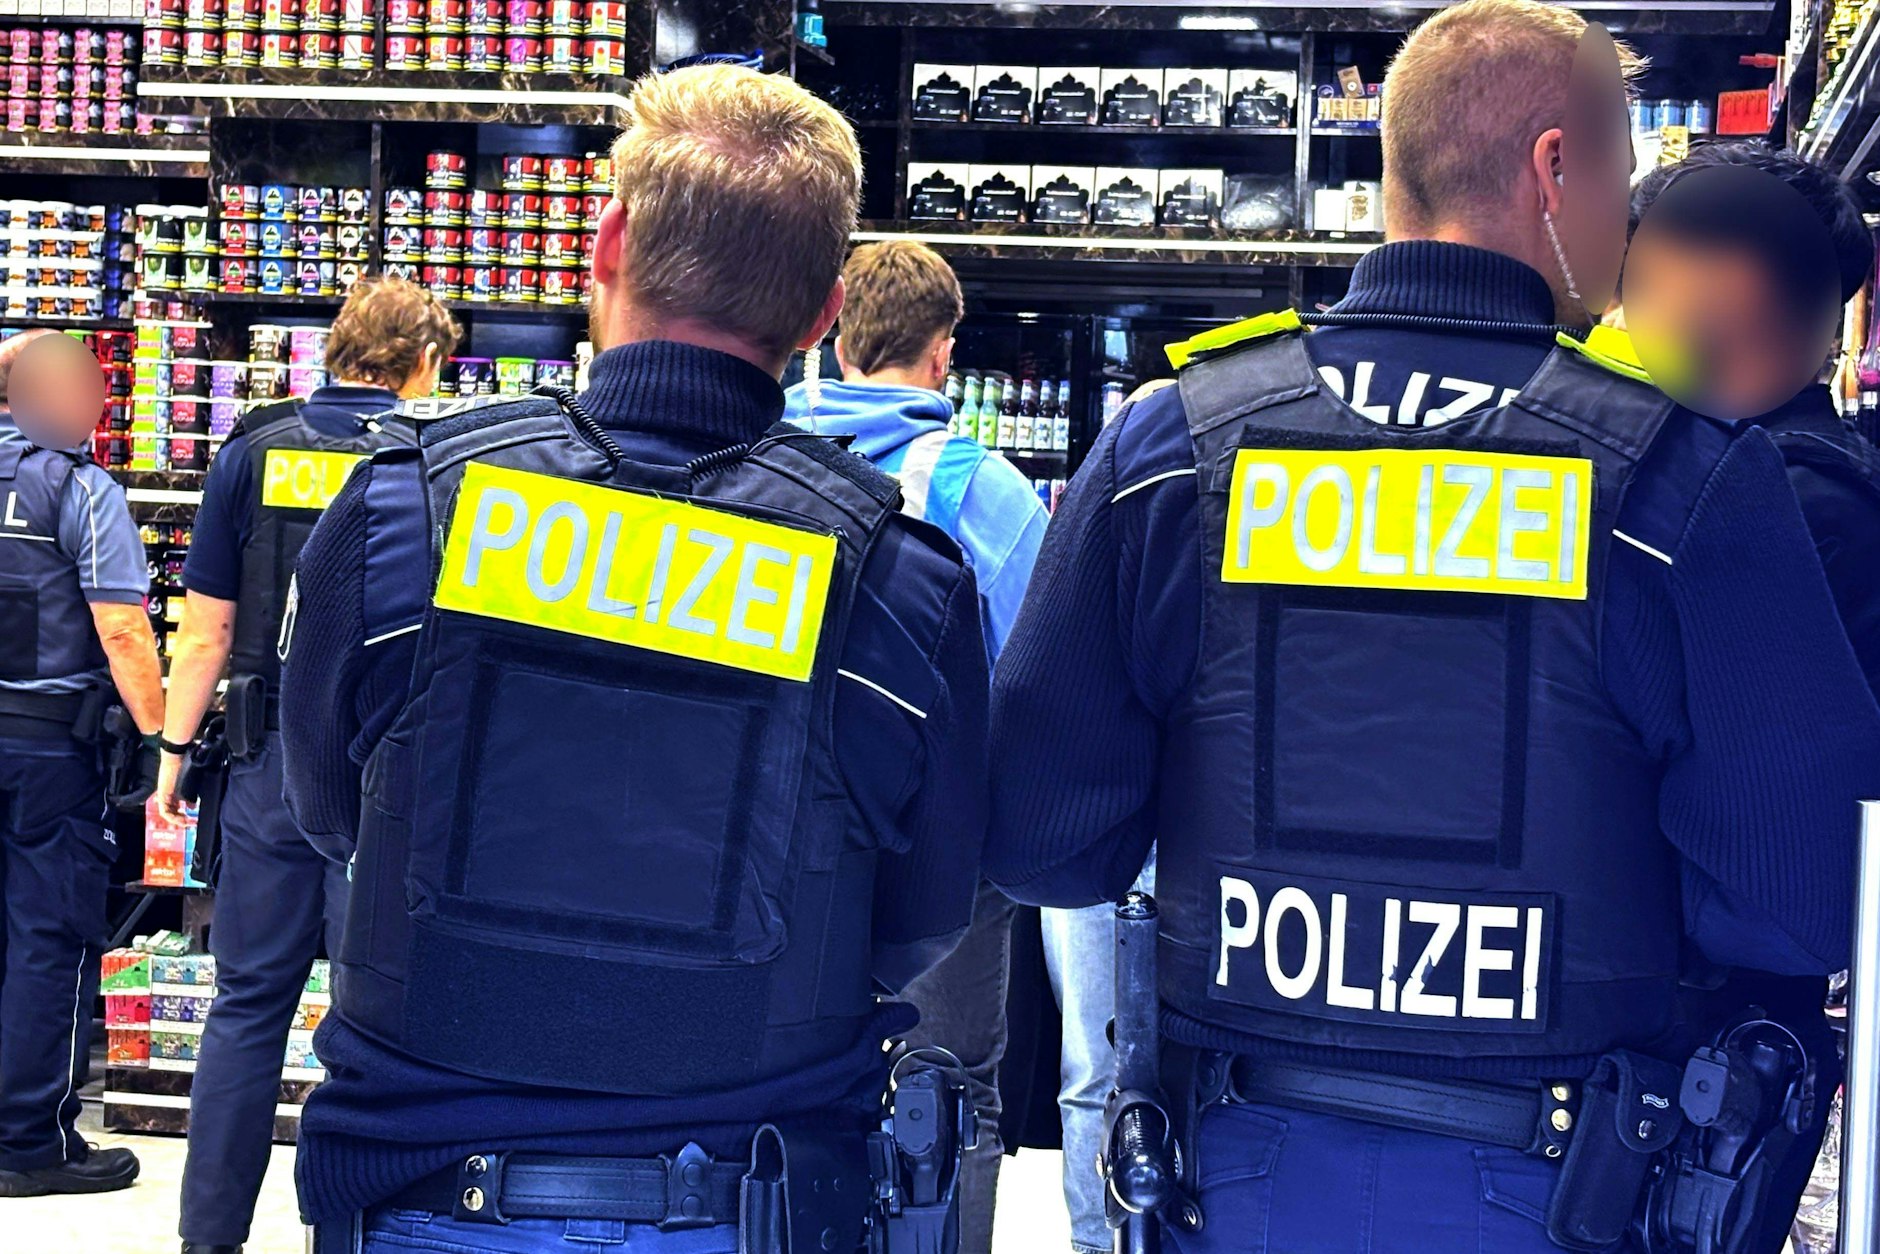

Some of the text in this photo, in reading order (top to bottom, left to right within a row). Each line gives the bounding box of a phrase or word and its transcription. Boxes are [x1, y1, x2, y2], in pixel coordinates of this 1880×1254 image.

[0, 491, 28, 528] L
[461, 487, 813, 654] POLIZEI
[1236, 463, 1577, 583] POLIZEI
[1216, 875, 1542, 1020] POLIZEI
